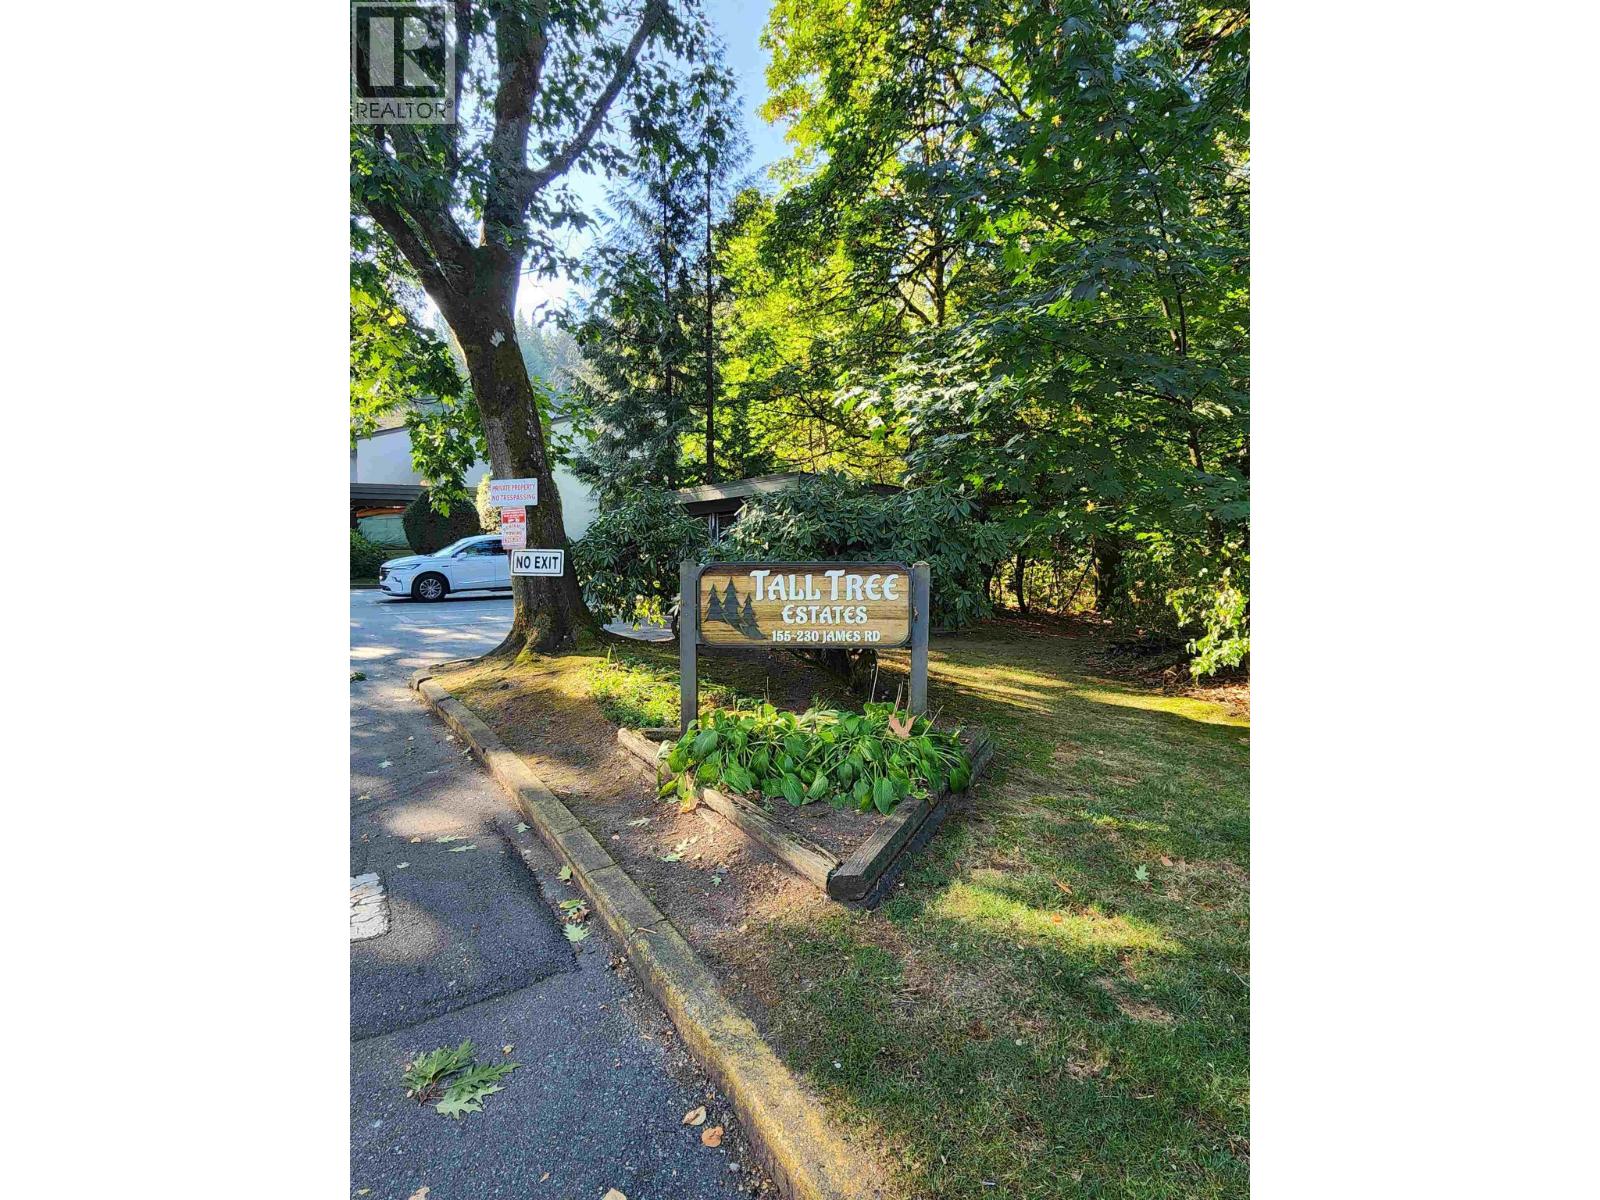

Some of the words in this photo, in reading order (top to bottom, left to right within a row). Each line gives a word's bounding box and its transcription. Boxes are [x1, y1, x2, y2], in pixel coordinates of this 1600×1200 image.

[511, 483, 535, 491] PROPERTY
[516, 556, 531, 569] NO
[534, 556, 559, 570] EXIT
[750, 569, 821, 601] TALL
[824, 569, 899, 601] TREE
[782, 604, 868, 625] ESTATES
[772, 630, 819, 643] 155-230
[822, 630, 861, 644] JAMES
[864, 630, 881, 643] RD
